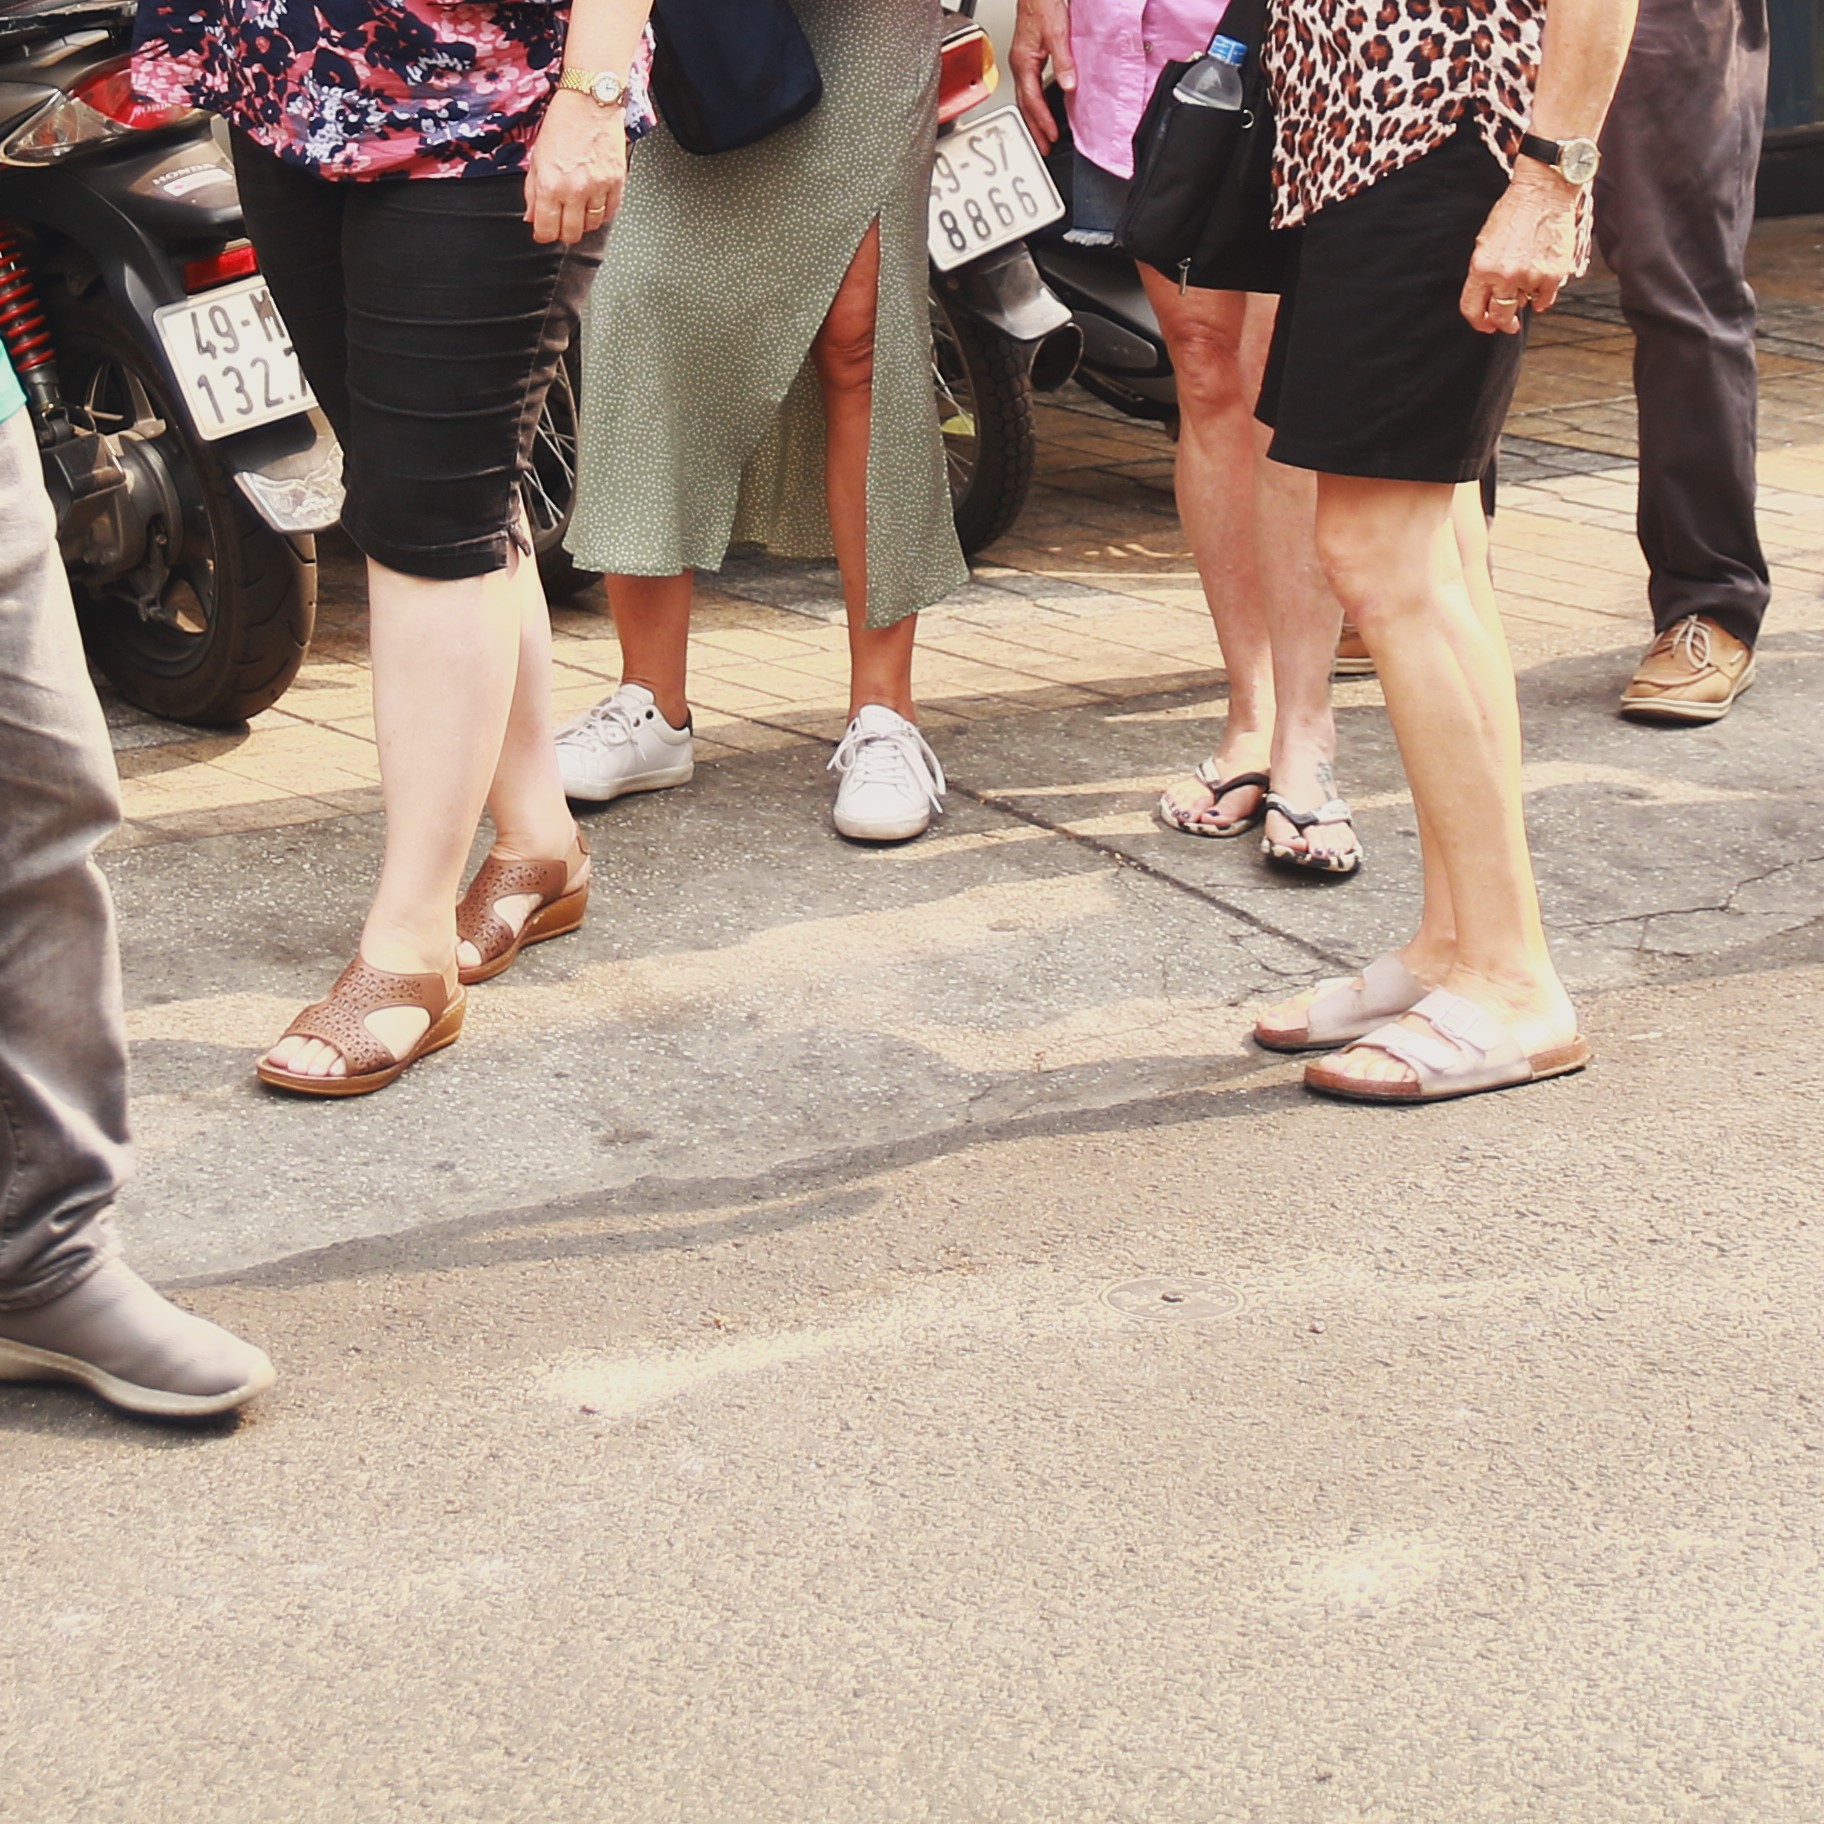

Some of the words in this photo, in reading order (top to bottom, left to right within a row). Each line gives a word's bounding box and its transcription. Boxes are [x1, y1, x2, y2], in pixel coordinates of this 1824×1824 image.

[938, 176, 1039, 252] 8866
[189, 288, 287, 361] 49-M
[197, 346, 309, 425] 132.7
